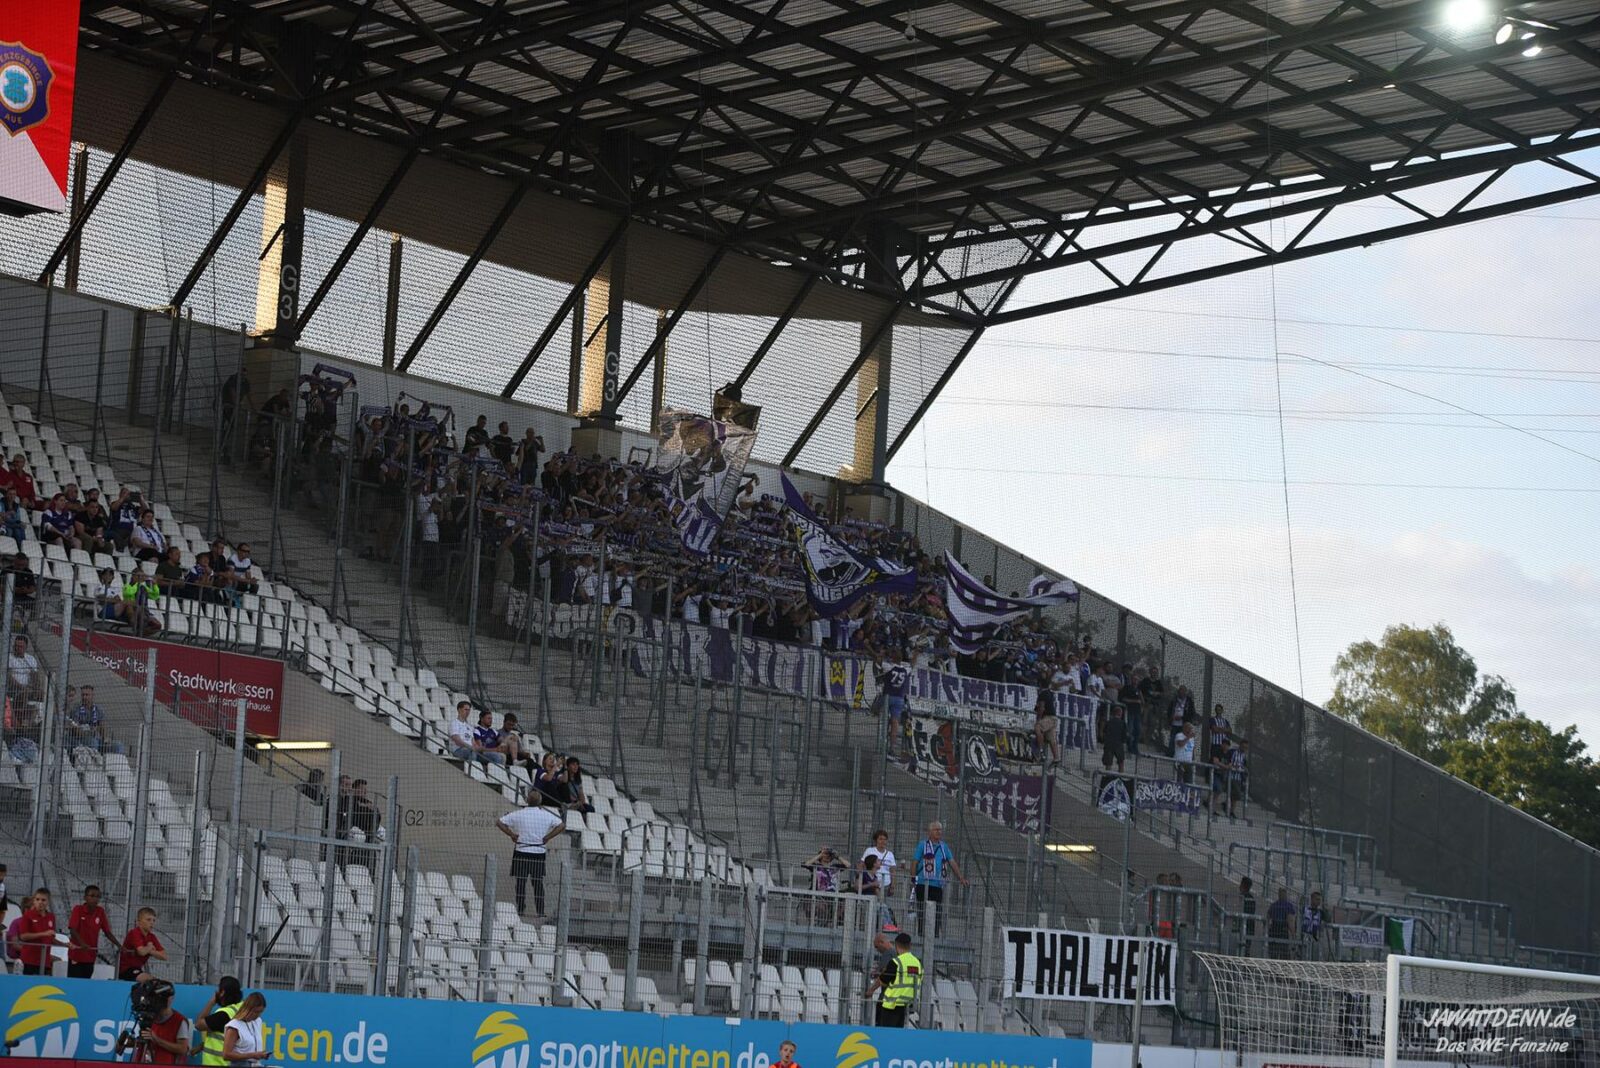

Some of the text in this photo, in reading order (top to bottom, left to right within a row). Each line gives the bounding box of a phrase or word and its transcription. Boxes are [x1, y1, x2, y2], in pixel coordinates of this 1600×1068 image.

[4, 113, 23, 124] AUE
[169, 669, 274, 700] Stadtwerkessen
[405, 809, 424, 826] G2
[1008, 930, 1172, 1001] THALHEIM
